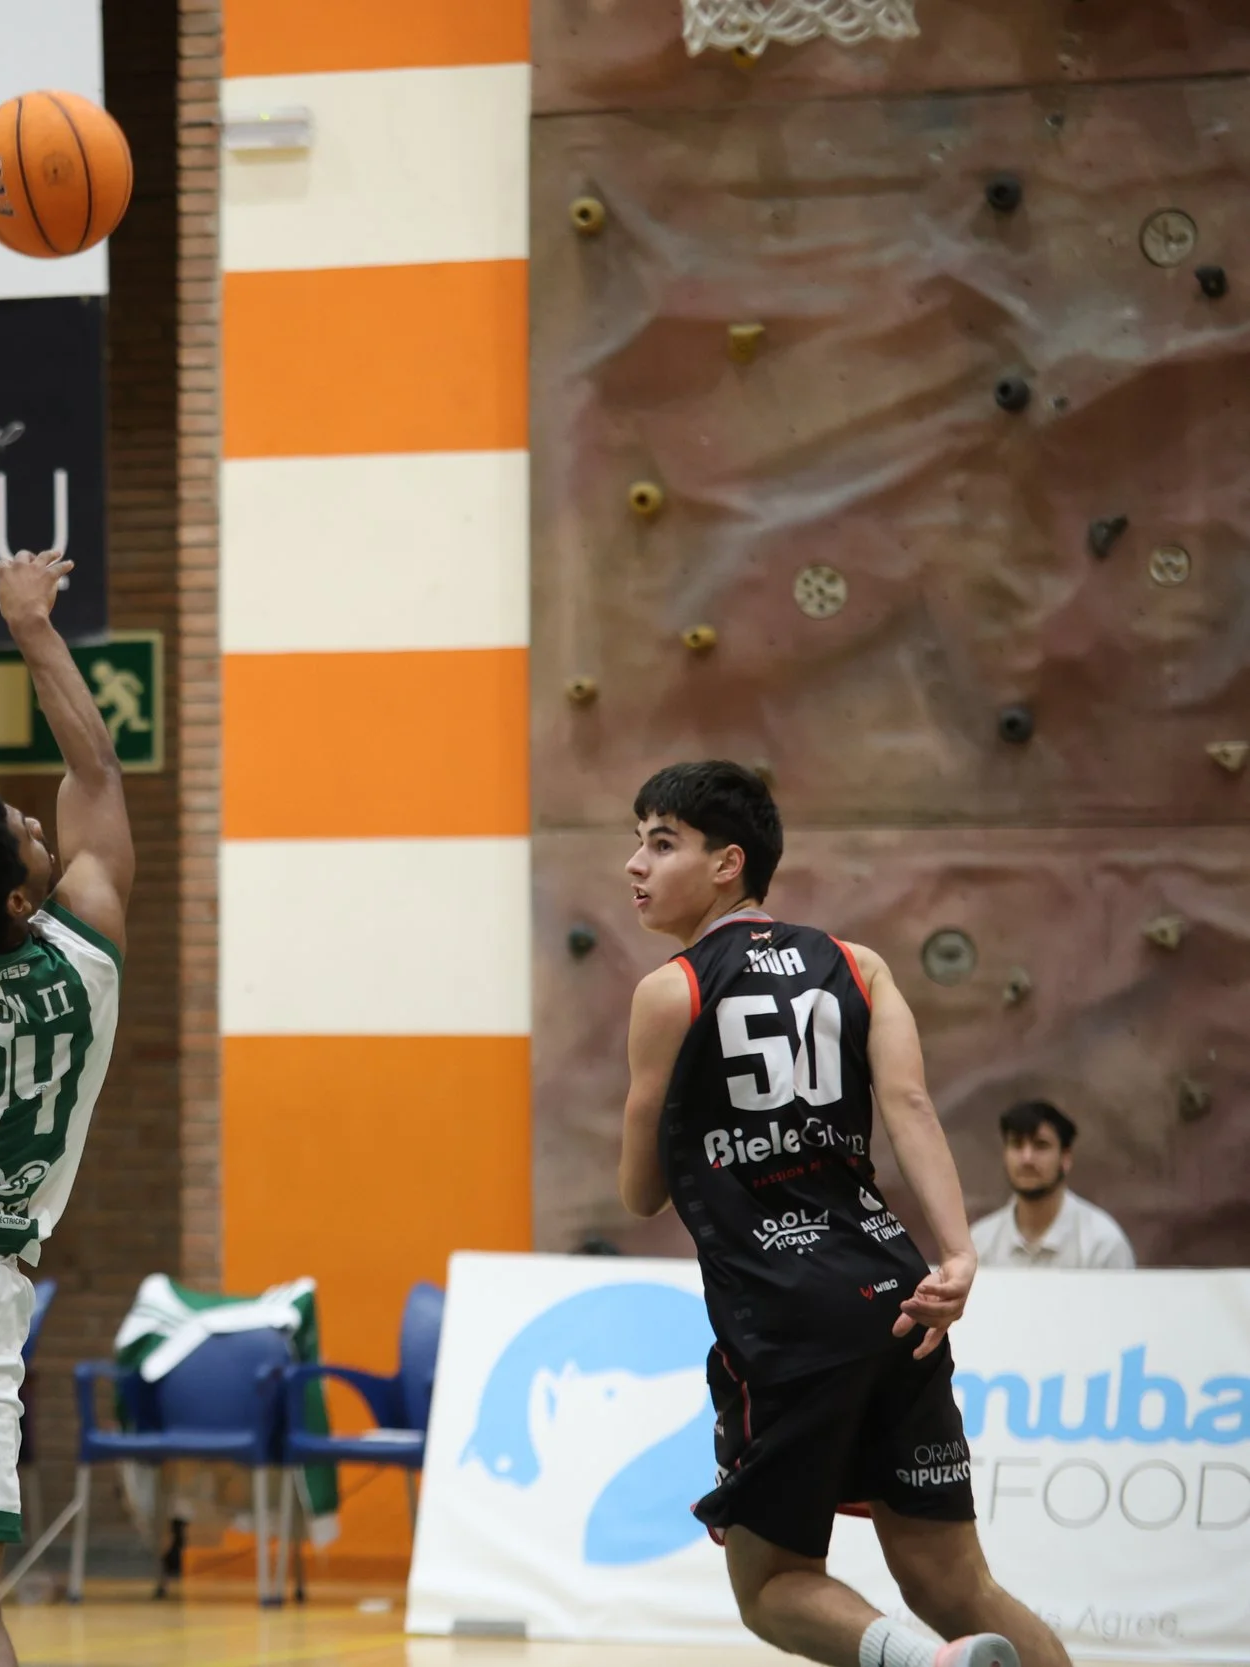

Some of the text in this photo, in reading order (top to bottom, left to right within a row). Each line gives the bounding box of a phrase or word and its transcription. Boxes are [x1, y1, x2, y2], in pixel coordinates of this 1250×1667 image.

[716, 987, 843, 1112] 50
[873, 1278, 899, 1293] WIBO
[914, 1440, 966, 1466] ORAIN
